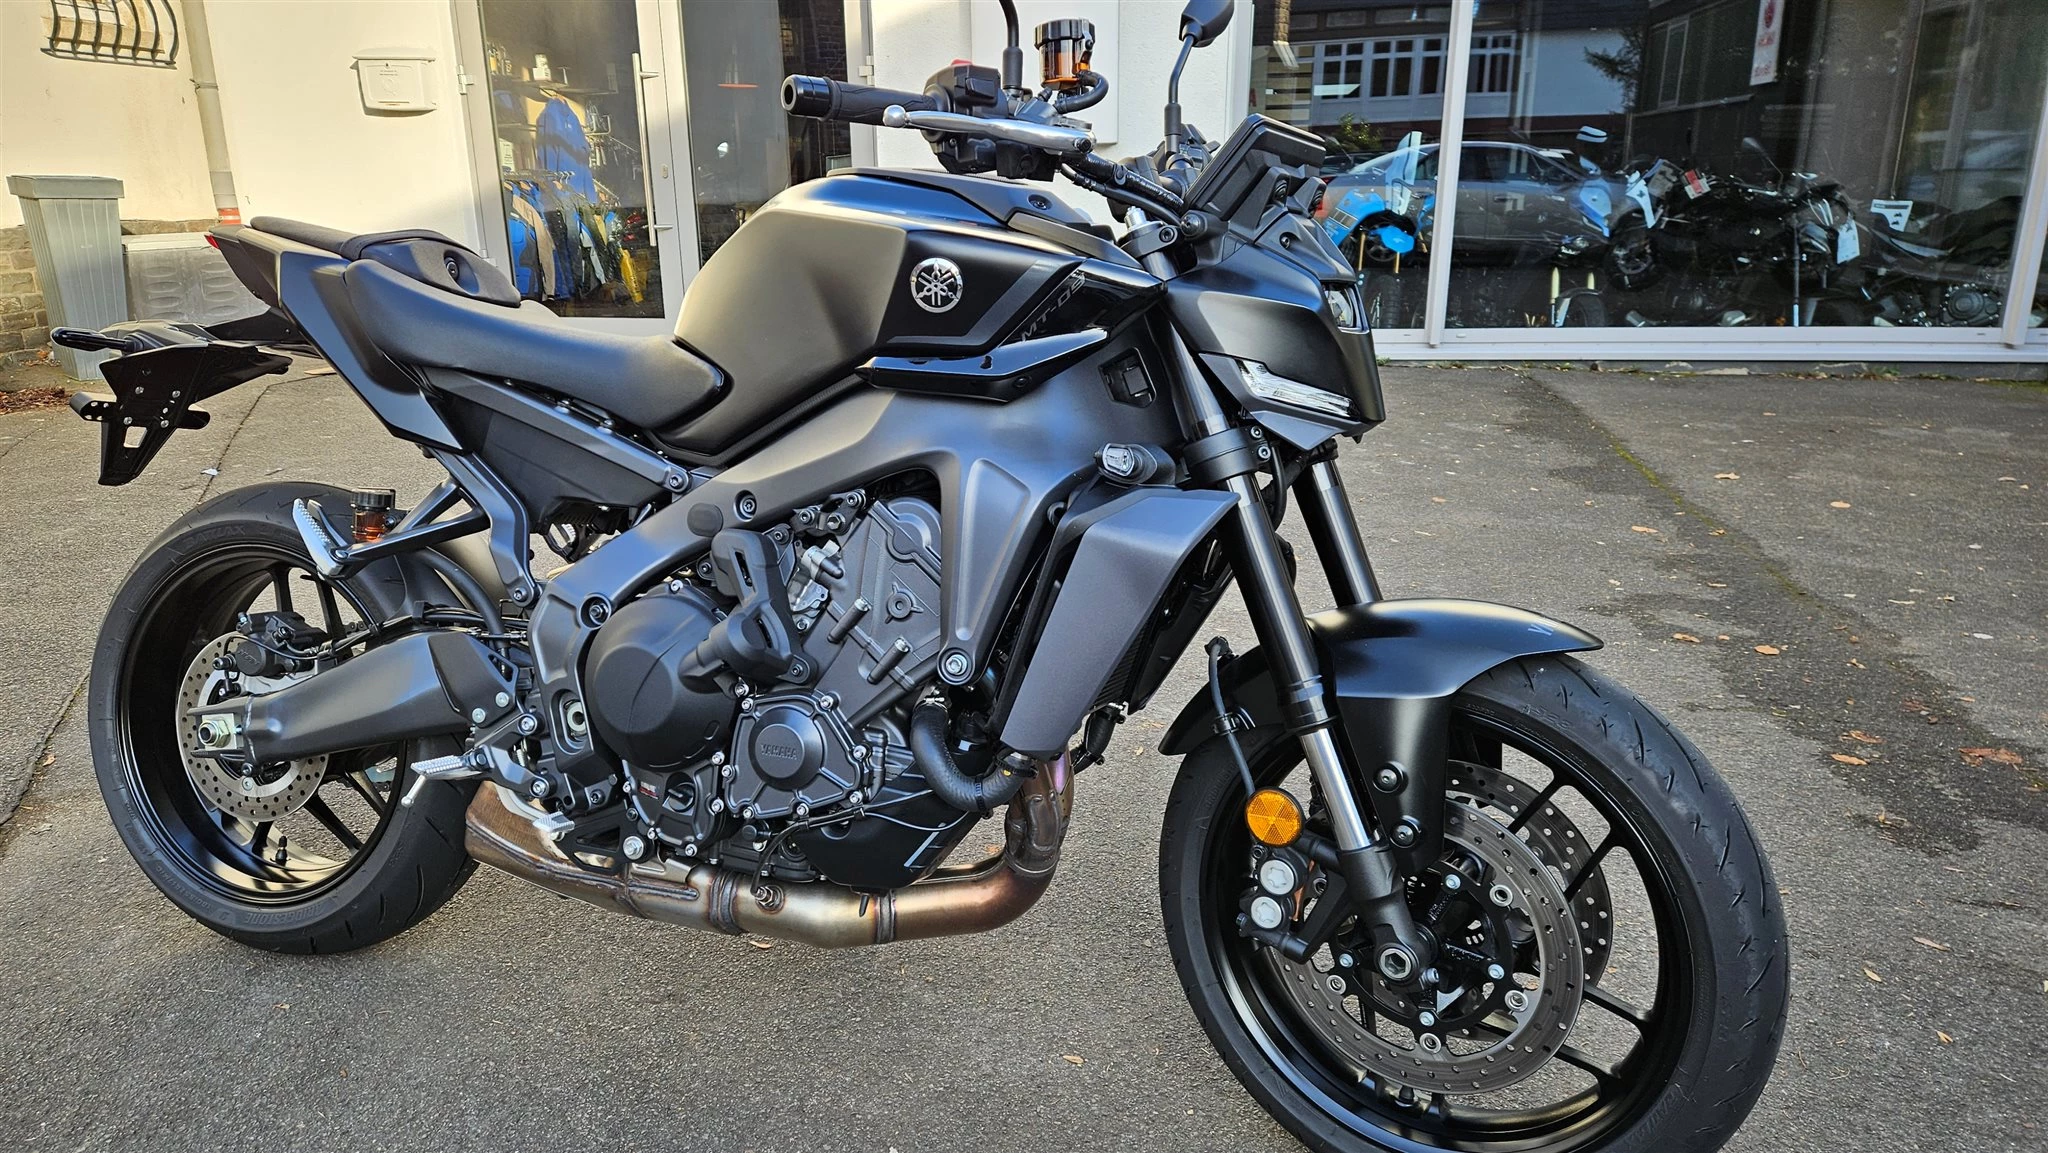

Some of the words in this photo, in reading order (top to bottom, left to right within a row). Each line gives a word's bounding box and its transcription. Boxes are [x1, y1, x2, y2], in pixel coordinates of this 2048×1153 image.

[1021, 268, 1086, 342] MT-09
[760, 743, 798, 761] YAMAHA
[243, 903, 322, 926] BRIDGESTONE
